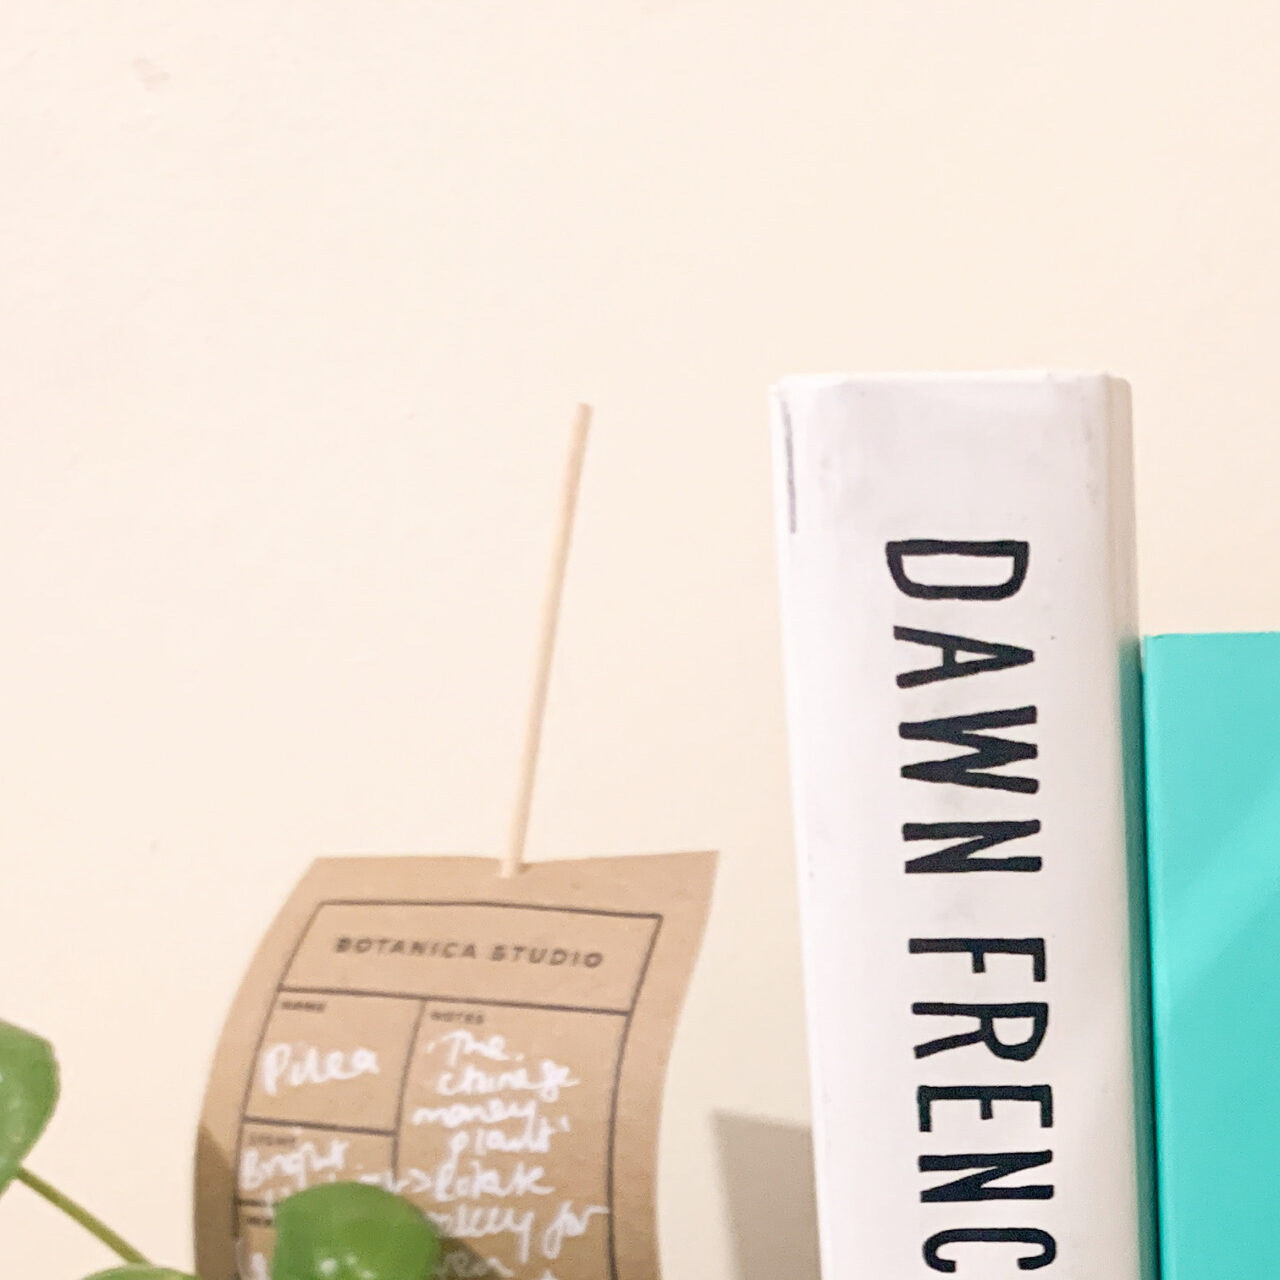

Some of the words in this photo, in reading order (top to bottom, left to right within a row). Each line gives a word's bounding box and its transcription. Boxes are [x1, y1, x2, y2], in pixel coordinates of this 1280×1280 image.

[884, 538, 1043, 875] DAWN
[334, 936, 476, 960] BOTANICA
[490, 944, 604, 969] STUDIO
